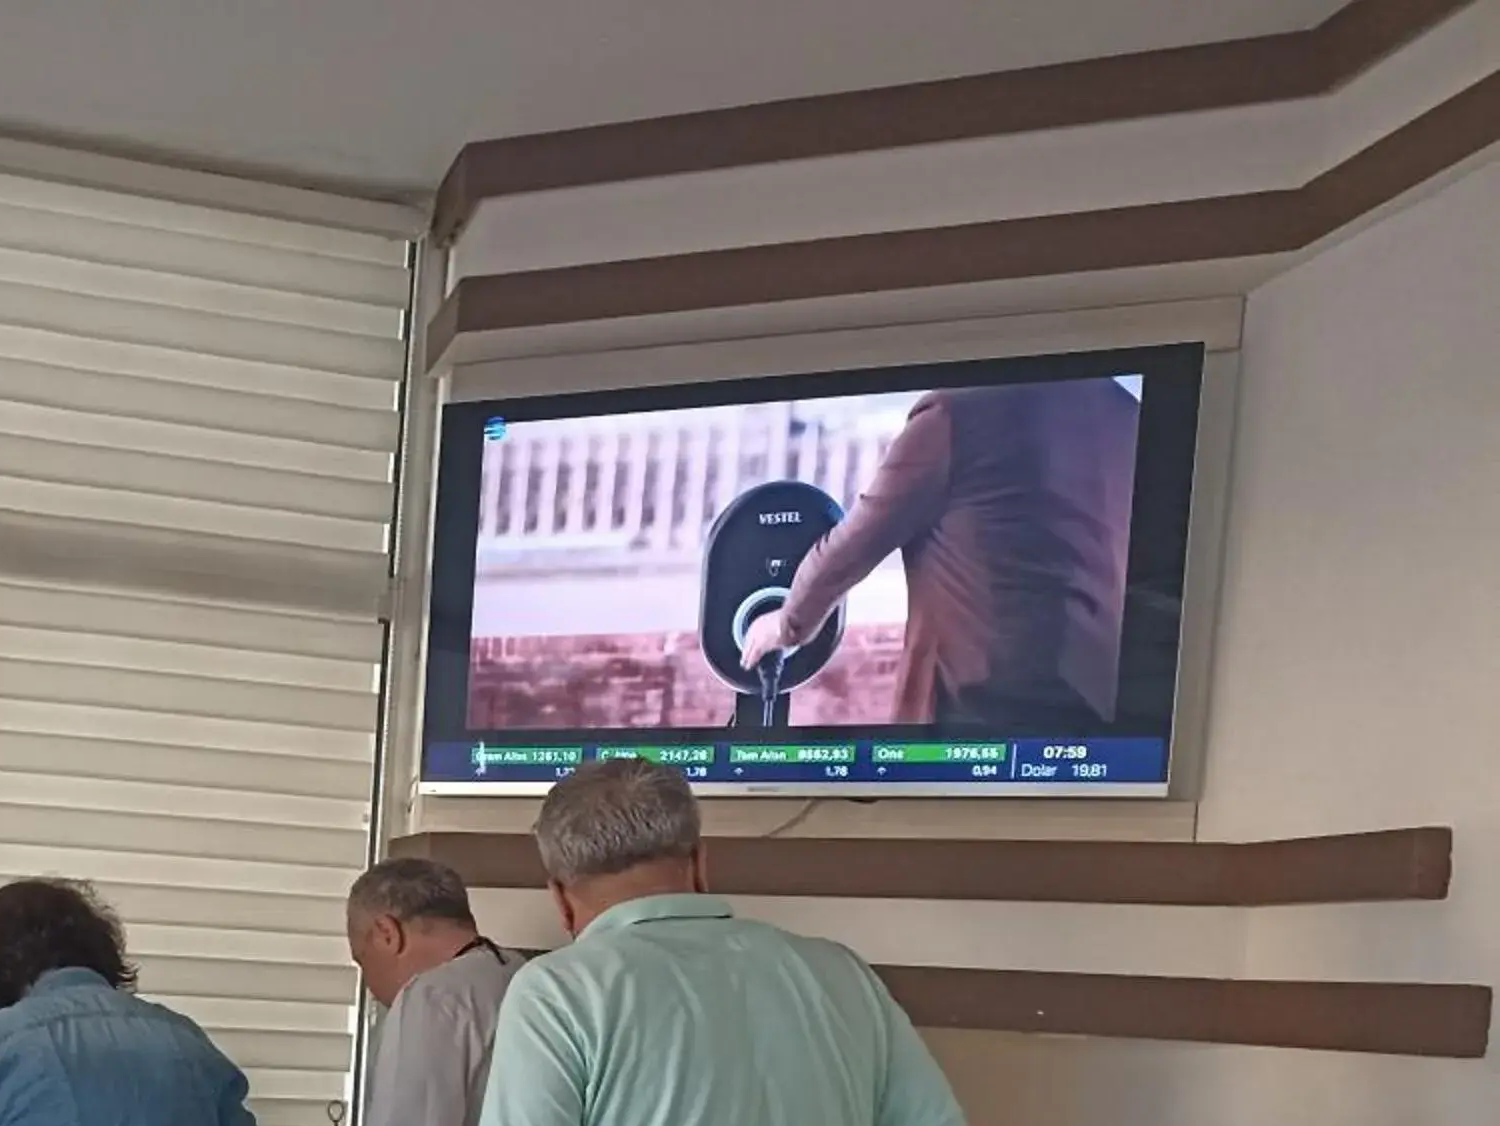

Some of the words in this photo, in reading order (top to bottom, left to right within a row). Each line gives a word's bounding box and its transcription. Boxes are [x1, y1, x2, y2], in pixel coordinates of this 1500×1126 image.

[759, 511, 802, 525] VESTEL
[1043, 745, 1088, 760] 07:59
[1021, 763, 1058, 777] Dolar
